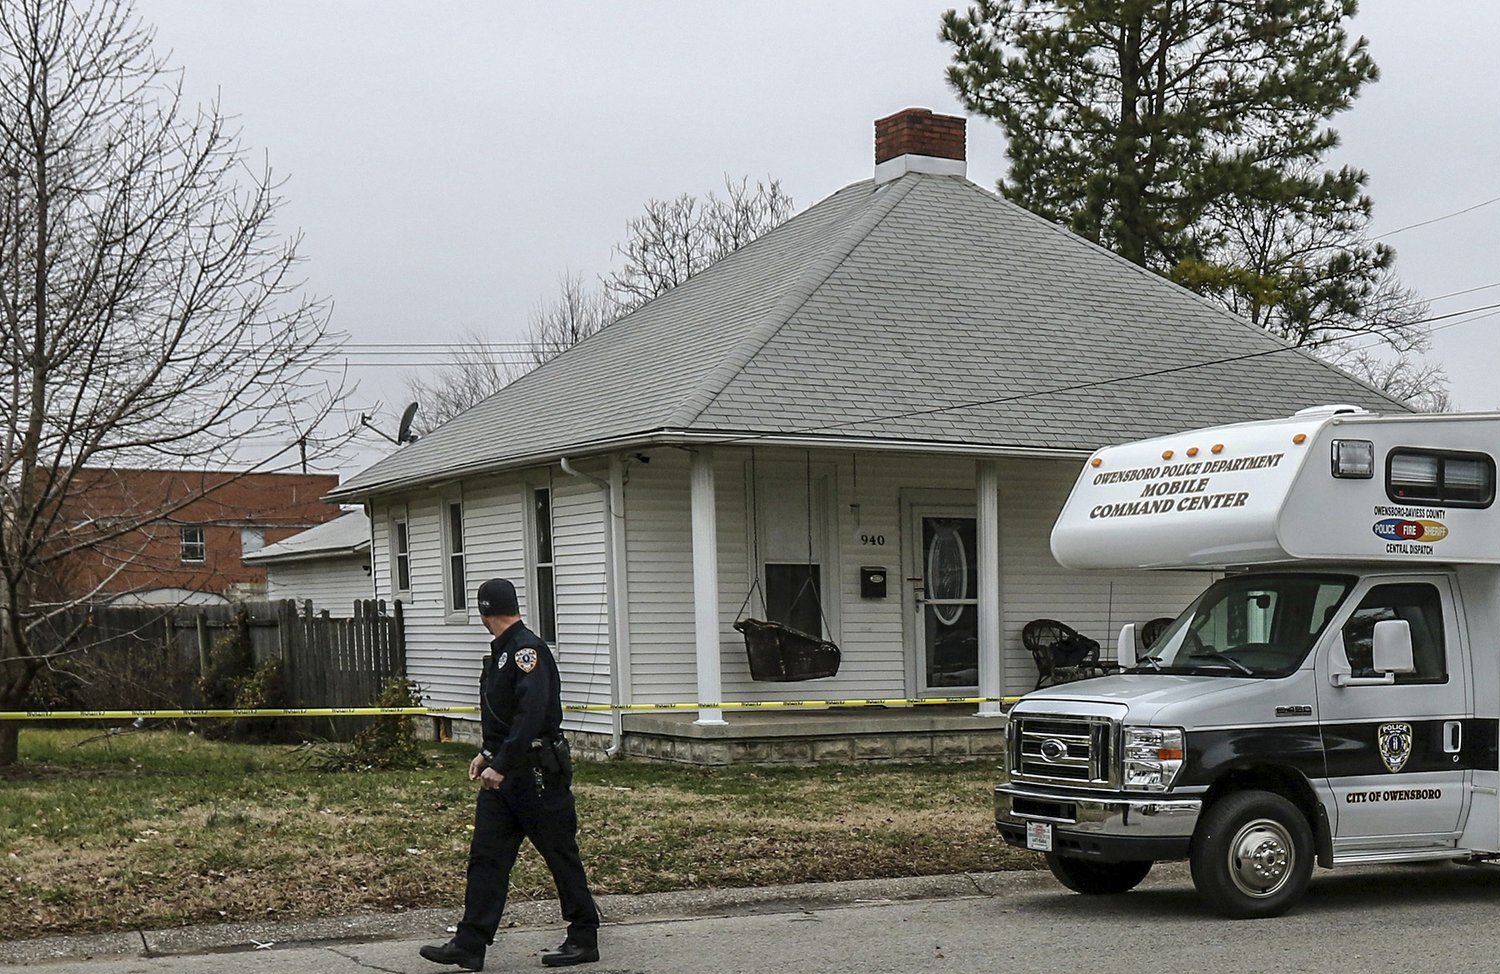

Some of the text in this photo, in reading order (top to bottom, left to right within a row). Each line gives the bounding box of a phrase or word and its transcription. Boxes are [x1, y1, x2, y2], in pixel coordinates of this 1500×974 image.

[1093, 453, 1285, 485] OWENSBORO POLICE DEPARTMENT
[1140, 478, 1211, 498] MOBILE
[1089, 492, 1250, 519] COMMAND CENTER
[1426, 509, 1446, 519] COUNTY
[1374, 524, 1396, 535] POLICE
[1403, 525, 1416, 535] FIRE
[861, 535, 885, 546] 940
[1386, 543, 1434, 555] CENTRAL DISPATCH
[1383, 724, 1408, 733] POLICE
[1346, 789, 1441, 803] CITY OF OWENSBORO
